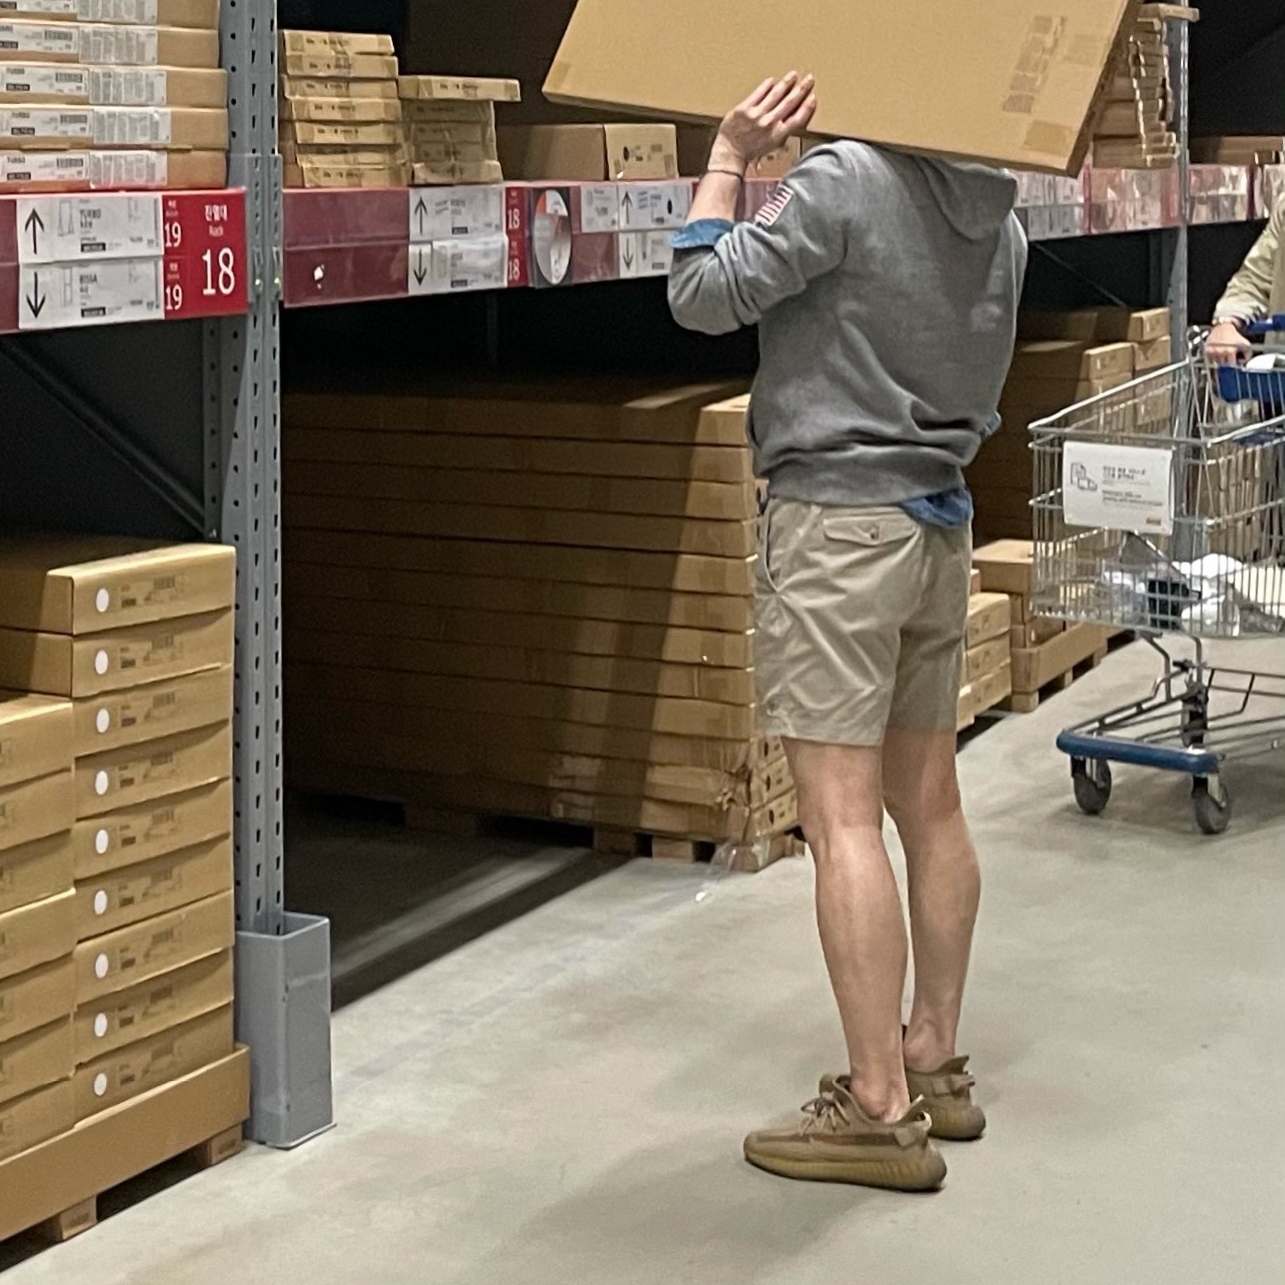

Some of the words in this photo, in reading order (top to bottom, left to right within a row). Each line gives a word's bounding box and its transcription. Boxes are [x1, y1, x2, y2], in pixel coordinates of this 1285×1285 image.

[508, 208, 520, 230] 18
[164, 221, 182, 248] 19
[202, 247, 235, 295] 18
[508, 259, 520, 281] 18
[165, 284, 183, 311] 19
